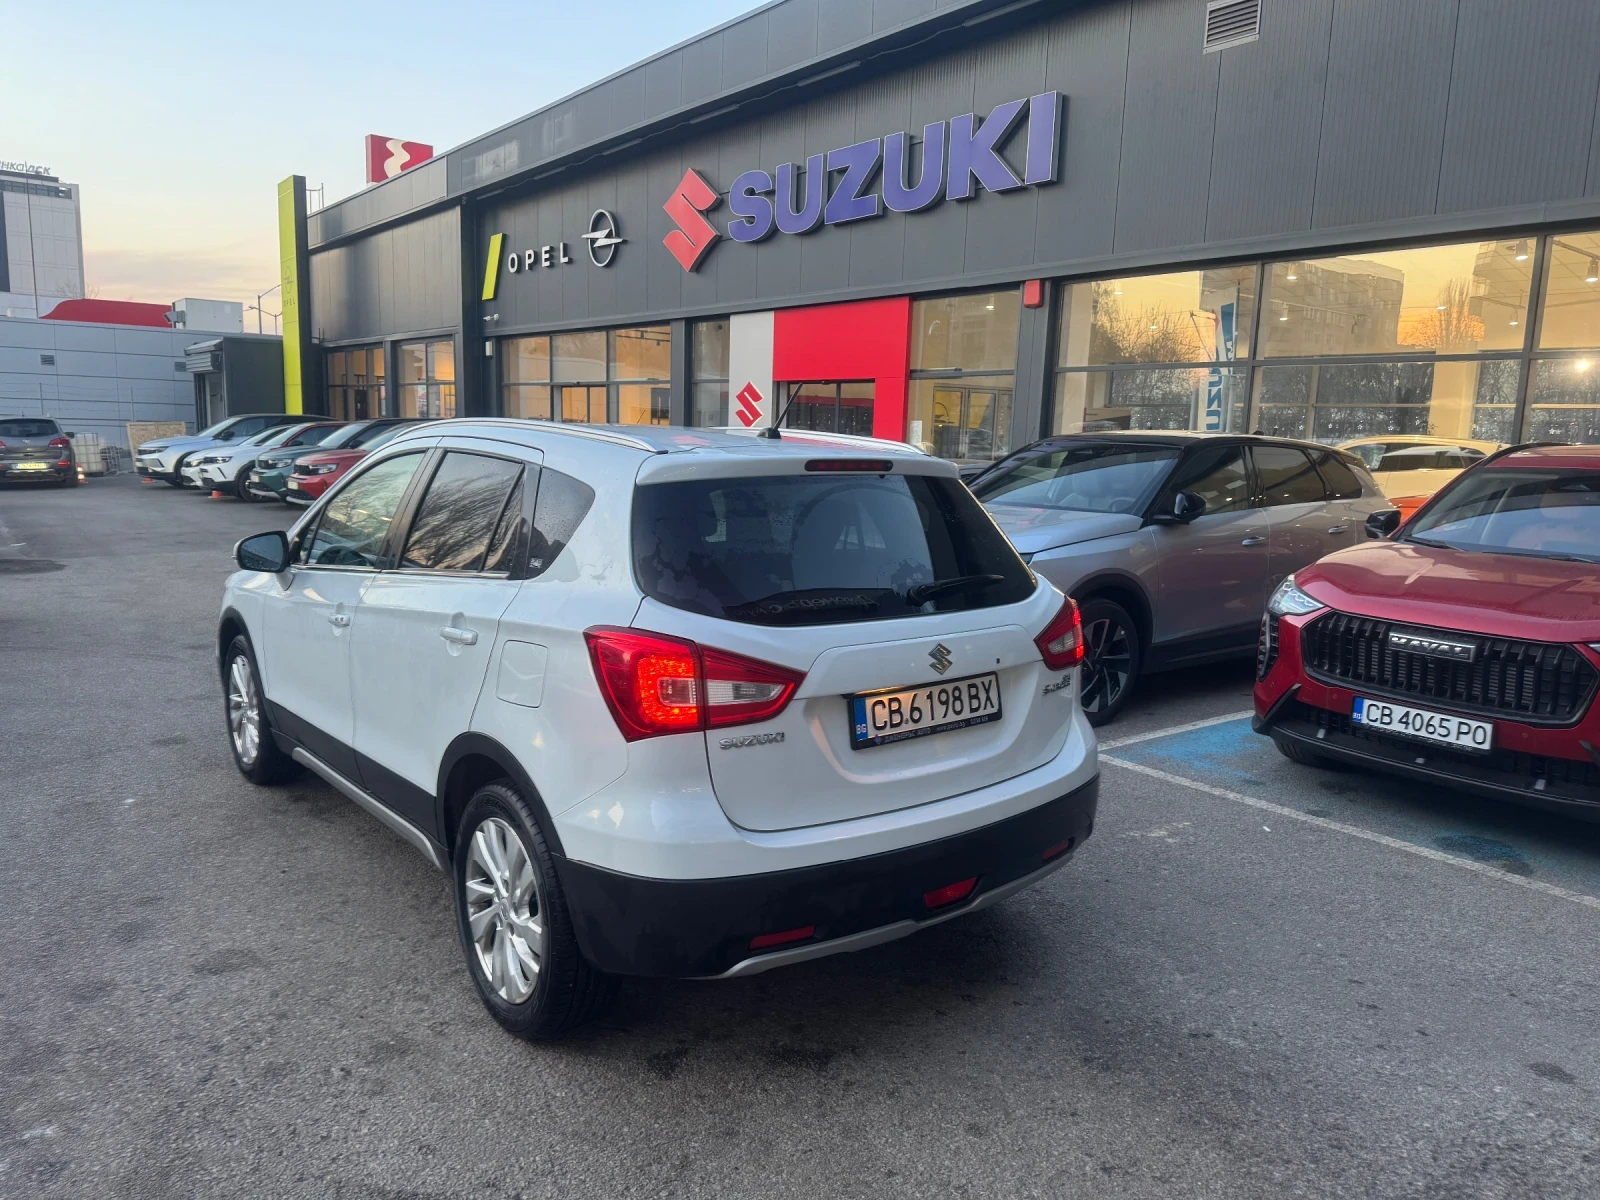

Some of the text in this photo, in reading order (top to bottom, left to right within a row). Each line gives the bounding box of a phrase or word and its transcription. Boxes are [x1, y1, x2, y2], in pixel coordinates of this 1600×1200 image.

[0, 160, 25, 172] нка
[727, 90, 1062, 243] SUZUKI
[507, 241, 573, 274] OPEL
[283, 297, 296, 307] OPEL
[909, 685, 964, 723] 6198
[1366, 703, 1393, 726] CB
[1397, 709, 1450, 737] 4065
[718, 731, 785, 750] SUZUKI
